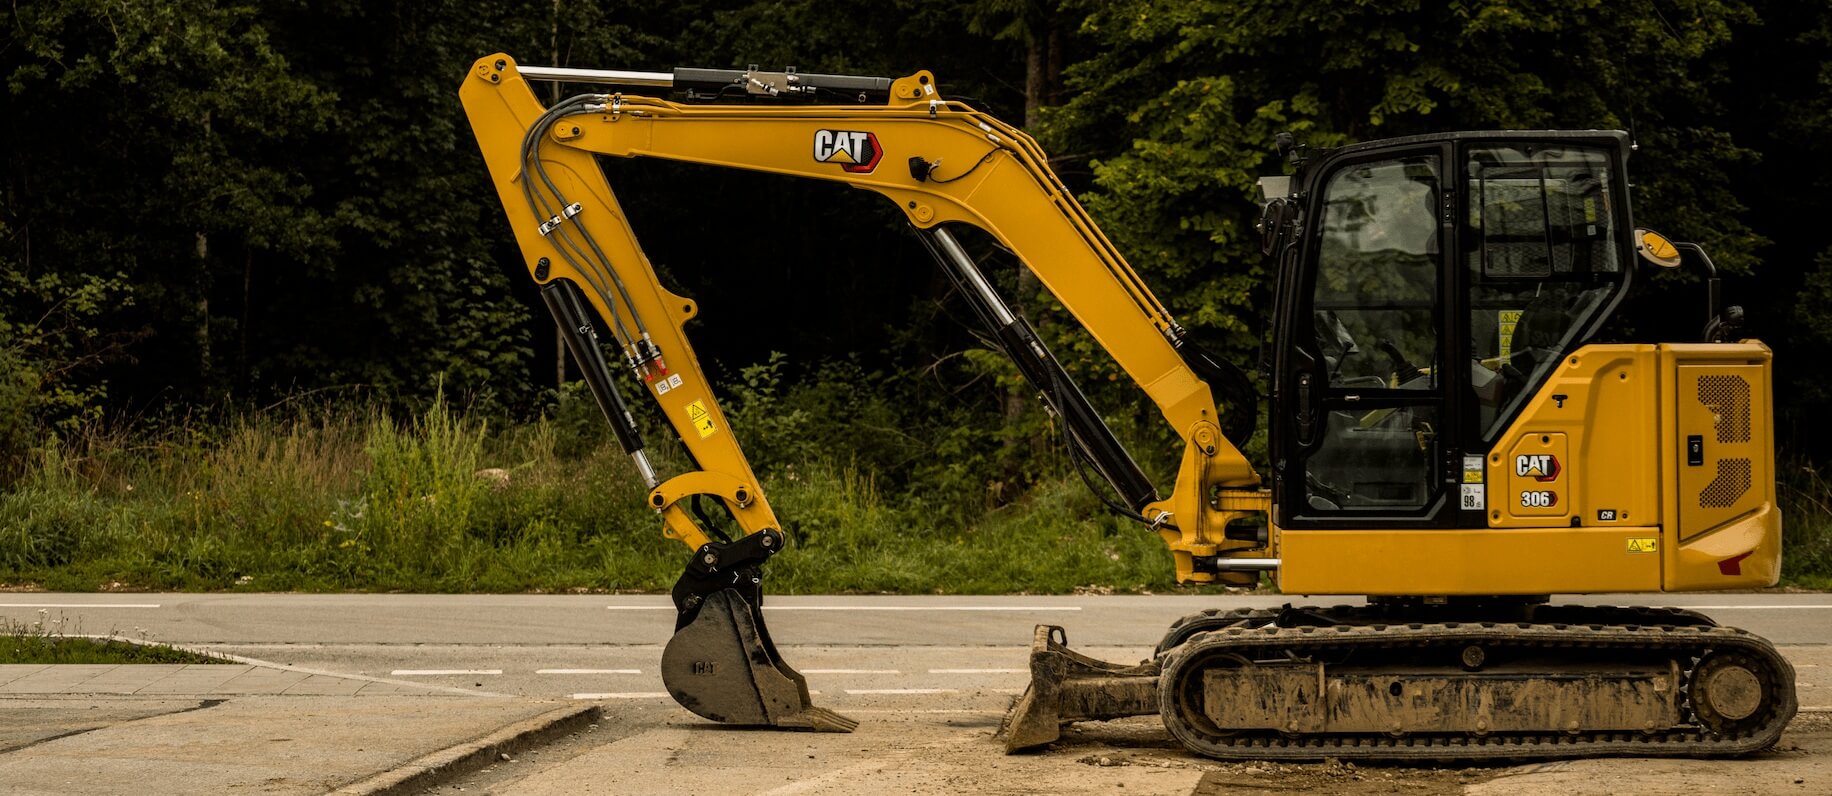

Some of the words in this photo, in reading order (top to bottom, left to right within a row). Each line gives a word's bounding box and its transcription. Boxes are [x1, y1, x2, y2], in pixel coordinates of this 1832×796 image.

[814, 129, 868, 163] CAT
[1516, 455, 1550, 476] CAT
[1464, 495, 1475, 508] 98
[1521, 491, 1550, 507] 306
[1601, 511, 1613, 520] CR
[694, 661, 720, 675] CAT
